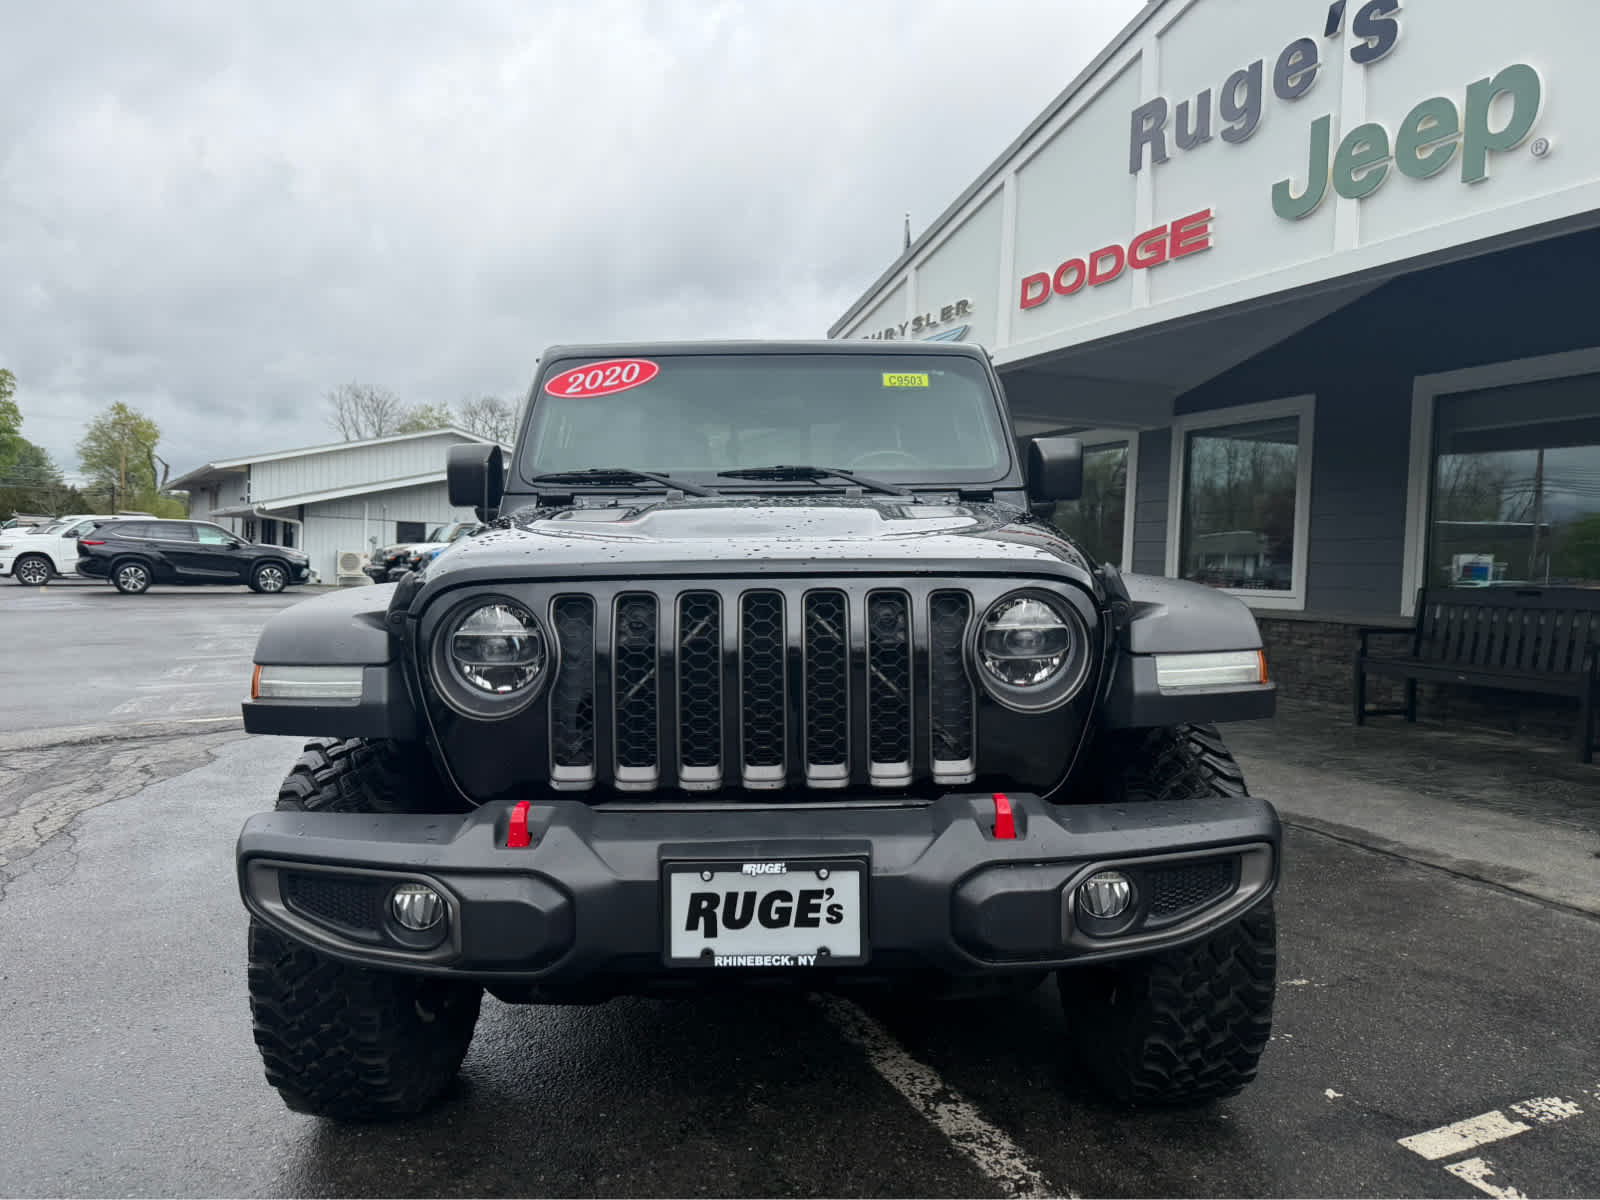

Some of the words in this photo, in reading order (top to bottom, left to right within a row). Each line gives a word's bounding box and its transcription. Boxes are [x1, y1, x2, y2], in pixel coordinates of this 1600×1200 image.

[1129, 0, 1400, 174] Ruge's
[1272, 63, 1542, 221] Jeep
[1020, 208, 1214, 309] DODGE
[565, 362, 640, 394] 2020
[888, 375, 923, 386] C9503
[685, 887, 844, 938] RUGE's
[798, 955, 817, 966] NY
